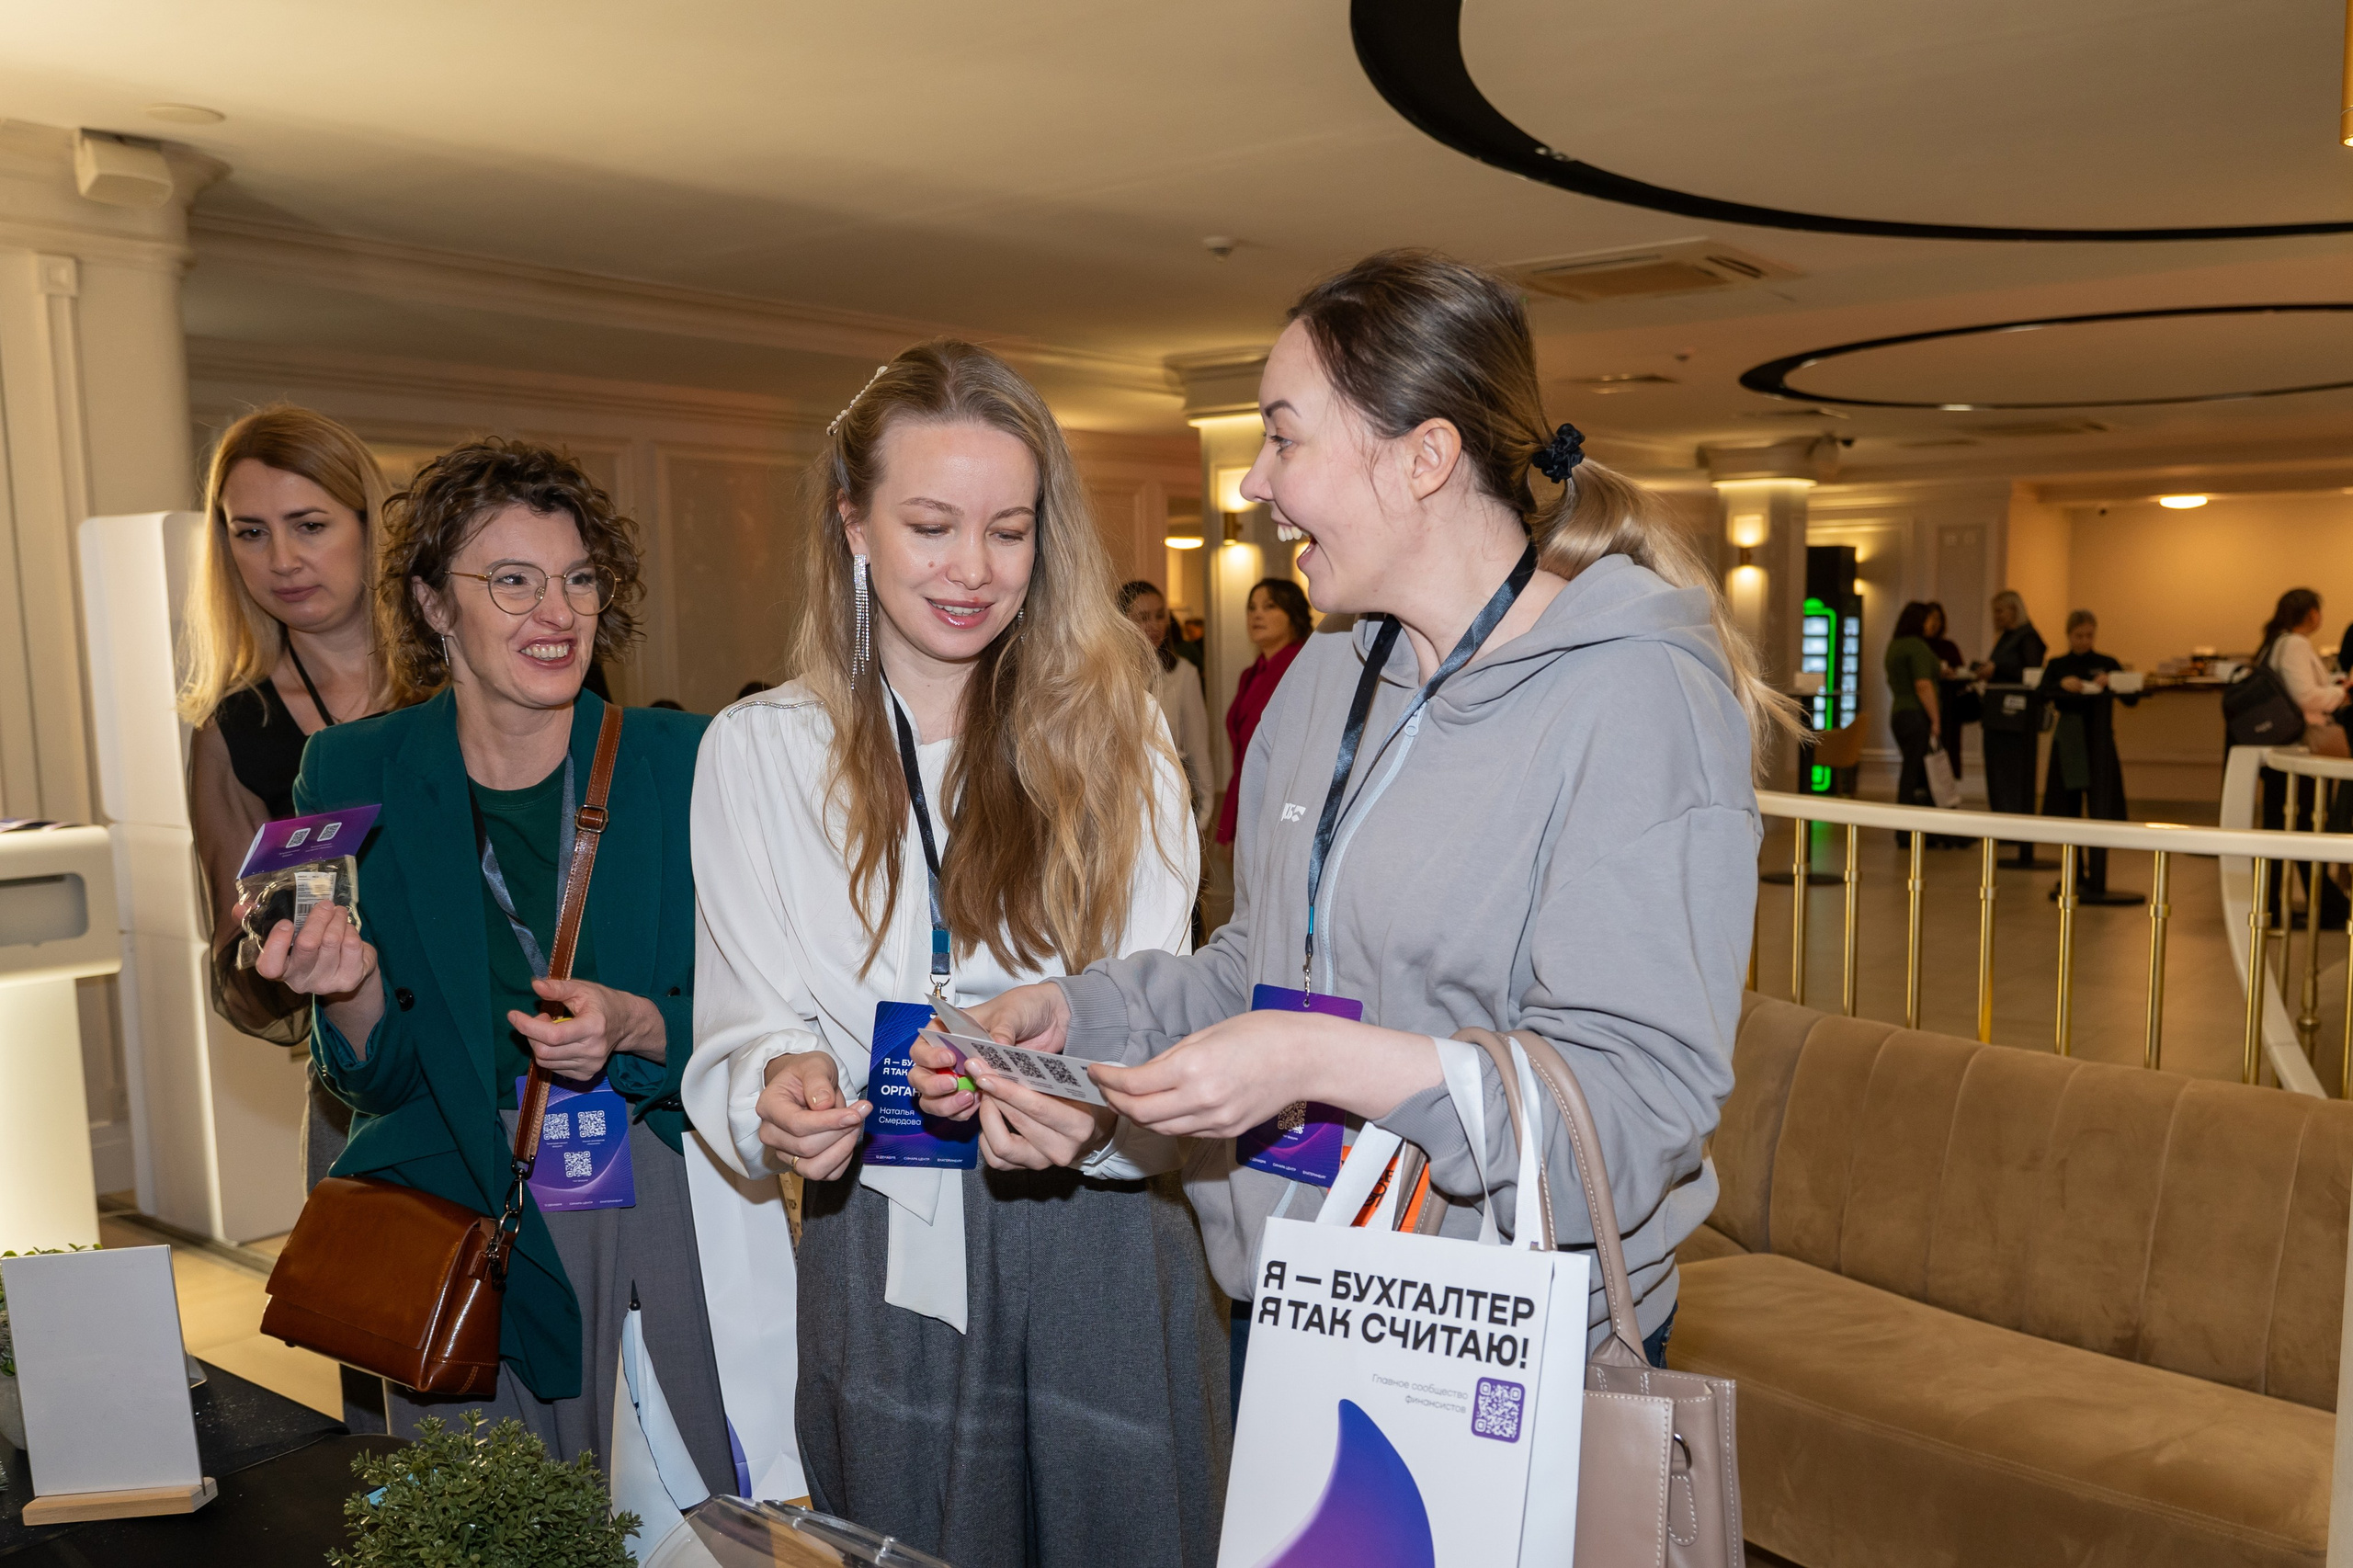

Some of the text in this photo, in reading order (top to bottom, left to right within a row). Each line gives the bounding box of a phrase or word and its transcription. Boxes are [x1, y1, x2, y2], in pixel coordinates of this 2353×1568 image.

[883, 1057, 891, 1065] Я
[882, 1067, 908, 1076] Я ТАК
[880, 1107, 915, 1116] Наталья
[878, 1116, 922, 1126] Смердова
[1263, 1259, 1288, 1290] Я
[1331, 1268, 1535, 1327] БУХГАЛТЕР
[1257, 1295, 1529, 1369] Я ТАК СЧИТАЮ!
[1372, 1373, 1469, 1401] Главное сообщество
[1404, 1394, 1467, 1415] финансистов
